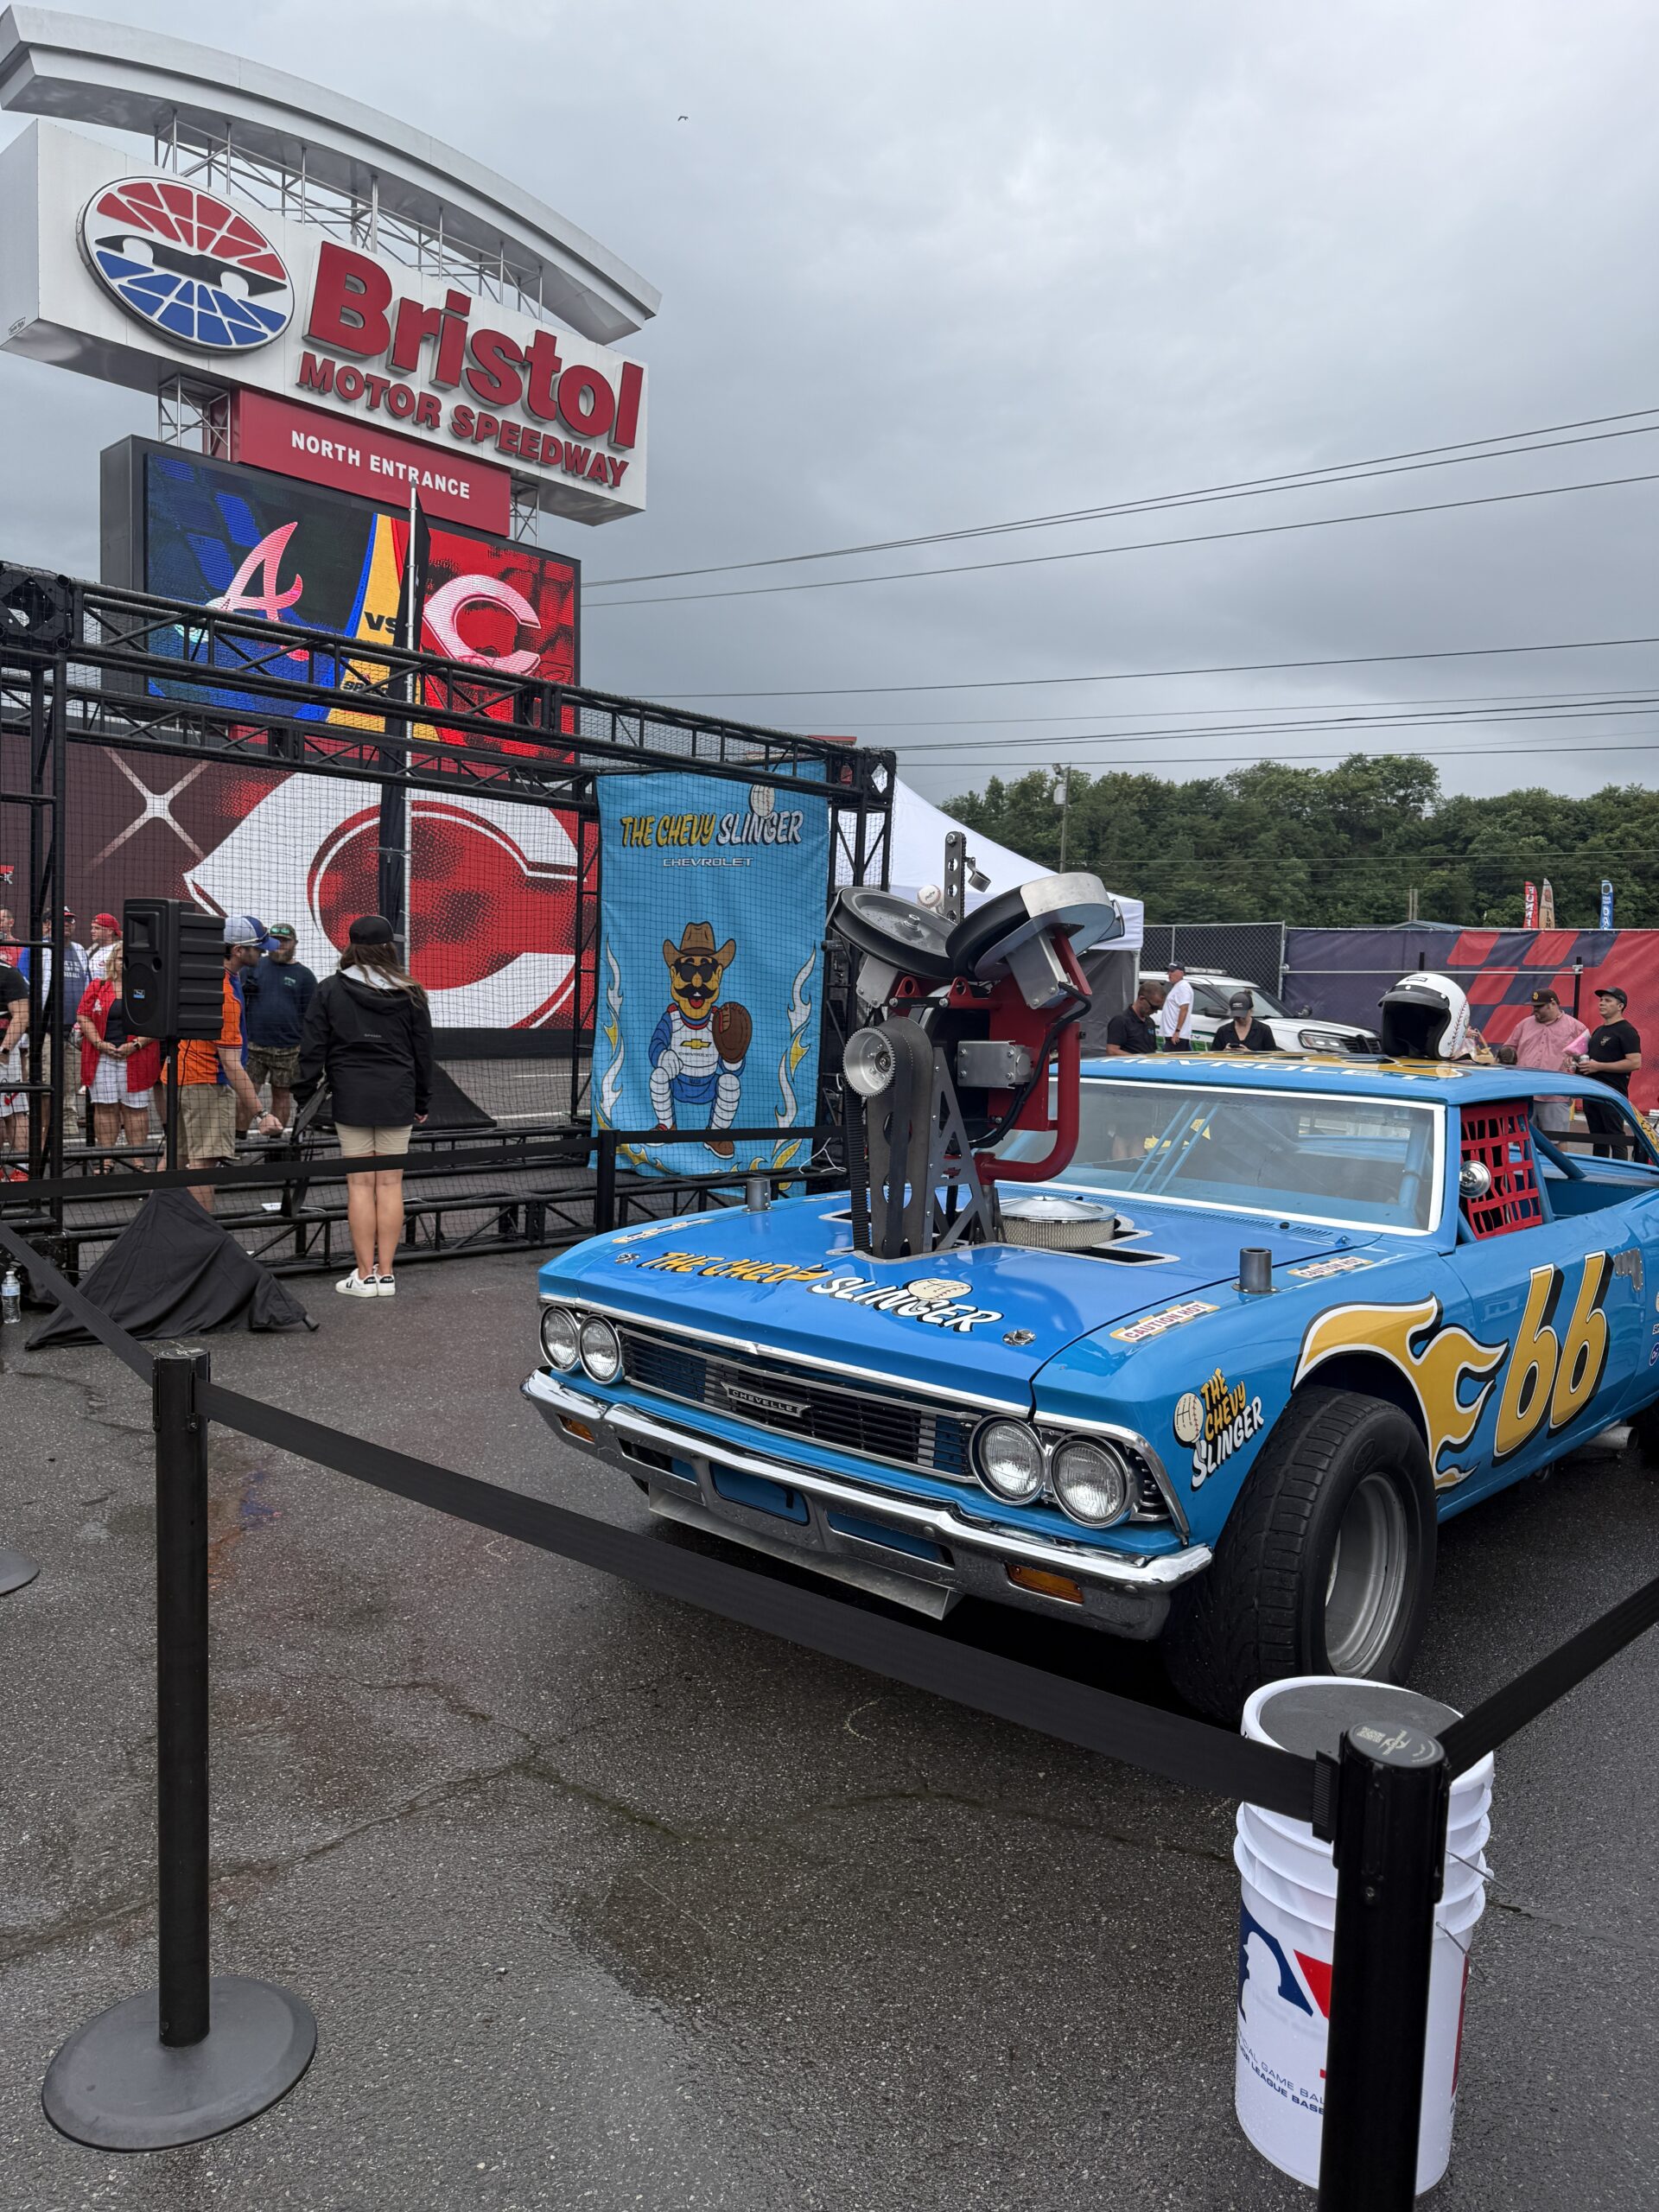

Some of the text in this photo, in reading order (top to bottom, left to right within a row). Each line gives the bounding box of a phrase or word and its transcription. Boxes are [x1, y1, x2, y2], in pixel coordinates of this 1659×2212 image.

[304, 240, 645, 450] Bristol
[297, 351, 630, 488] MOTOR SPEEDWAY
[291, 430, 470, 499] NORTH ENTRANCE
[620, 809, 804, 848] THE CHEVY SLINGER
[663, 856, 754, 868] CHEVROLET
[639, 1252, 726, 1273] THE
[808, 1276, 1004, 1333] SLINGER
[1124, 1303, 1210, 1339] CAUTION HOT
[1492, 1249, 1611, 1459] 66
[732, 1390, 793, 1412] CHEVELLE
[1200, 1368, 1228, 1410] THE
[1205, 1381, 1246, 1441] CHEVY
[1191, 1395, 1264, 1488] SLINGER
[1251, 2062, 1287, 2097] LEAGUE
[1261, 2062, 1294, 2091] GAME
